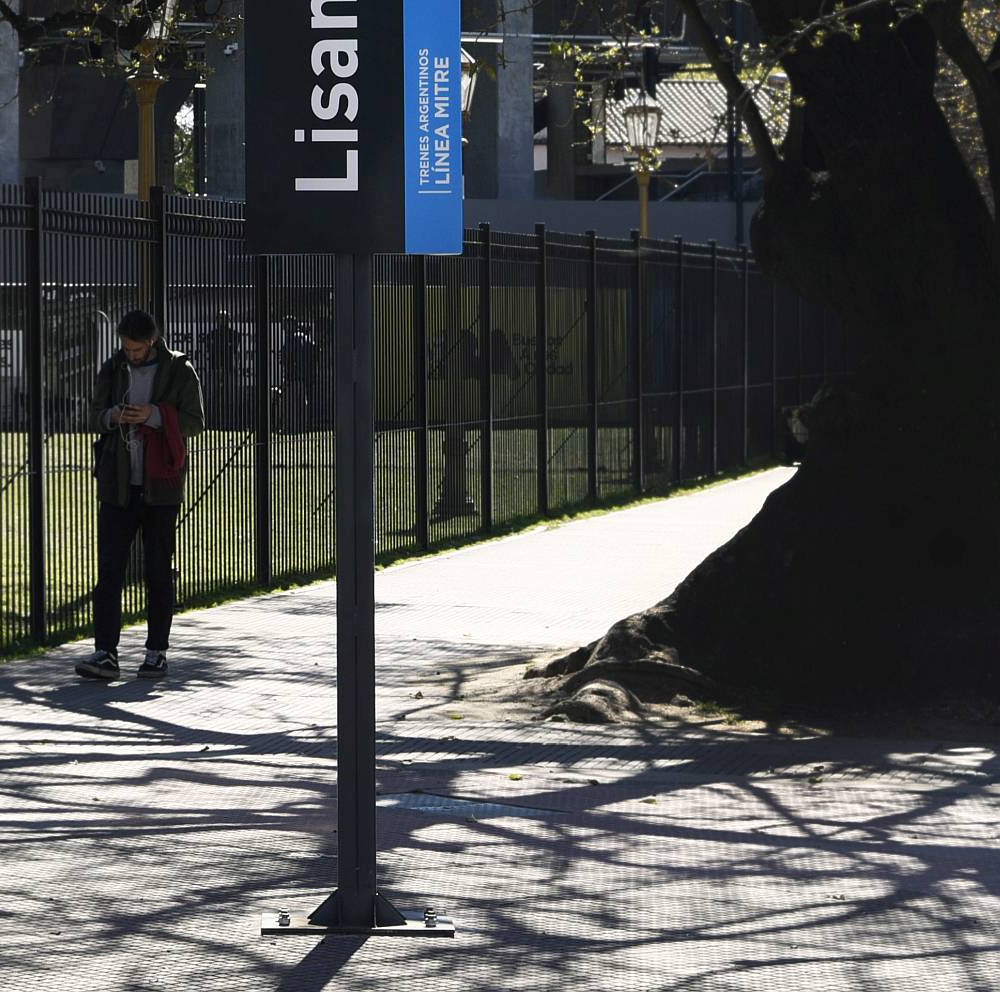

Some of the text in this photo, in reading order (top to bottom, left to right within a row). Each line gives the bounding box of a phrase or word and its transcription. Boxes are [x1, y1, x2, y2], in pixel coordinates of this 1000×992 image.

[419, 49, 429, 186] TRENES ARGENTINOS
[431, 57, 450, 184] LÍNEA MITRE
